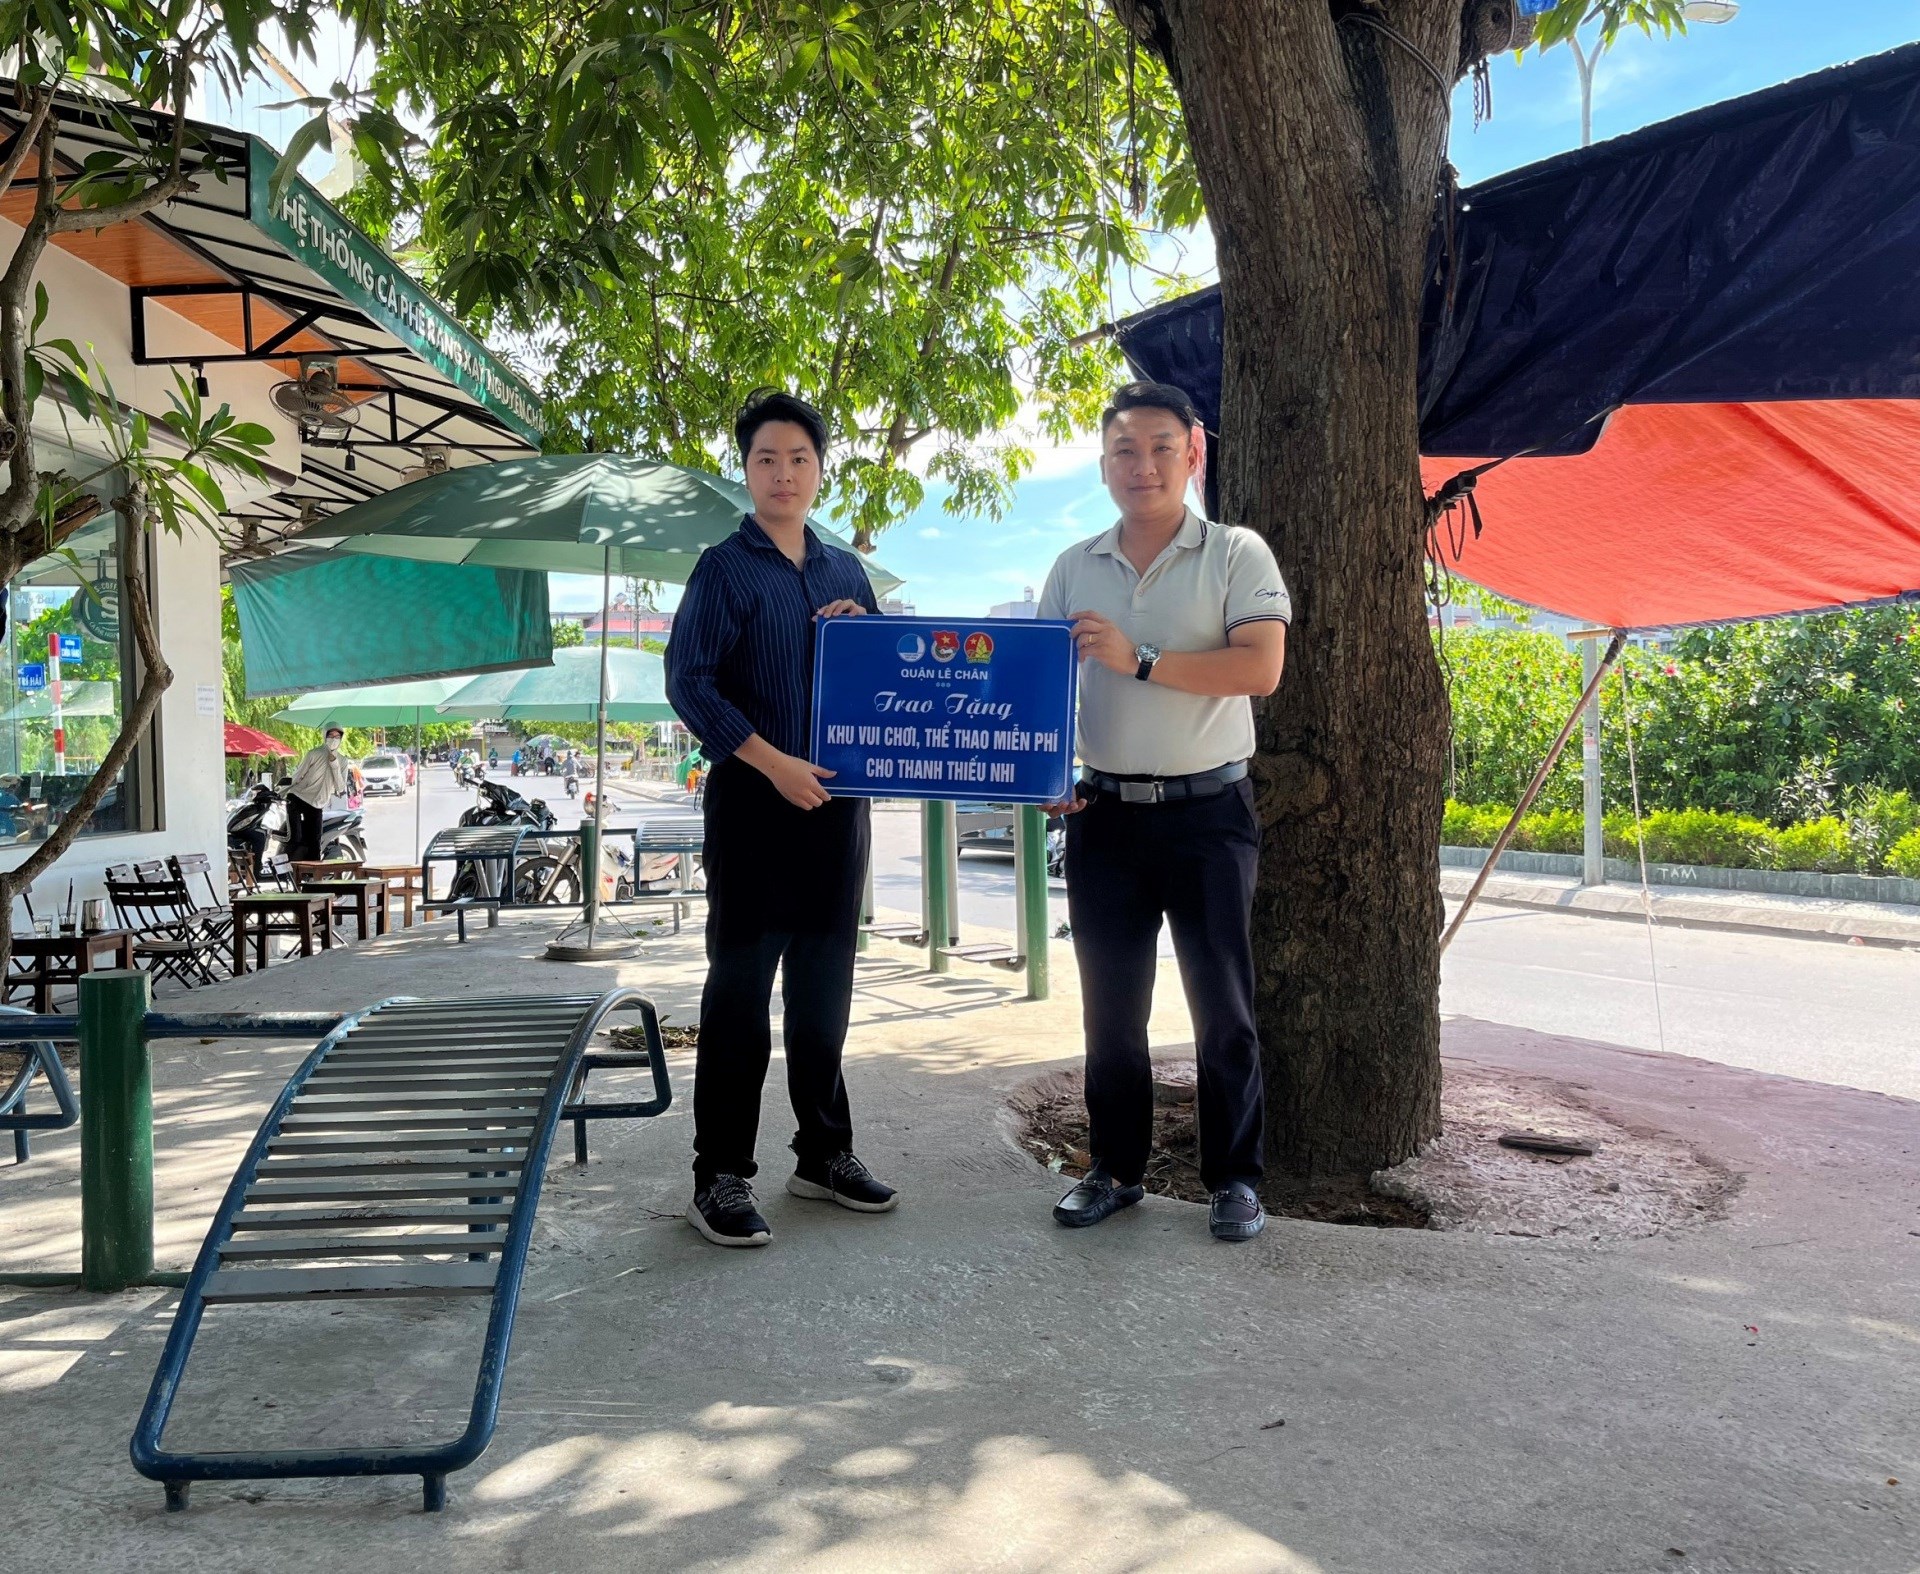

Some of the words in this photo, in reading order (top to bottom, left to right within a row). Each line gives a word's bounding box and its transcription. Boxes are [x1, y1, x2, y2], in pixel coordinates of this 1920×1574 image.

[280, 193, 308, 248] HỆ
[308, 214, 374, 291] THỐNG
[375, 273, 398, 318] CÀ
[398, 293, 427, 337] PHÊ
[427, 315, 462, 366] RANG
[901, 667, 935, 681] QUẬN
[938, 668, 952, 680] LÊ
[955, 669, 989, 681] CHÂN
[874, 691, 935, 713] Trao
[945, 693, 1014, 721] Tặng
[827, 725, 855, 745] KHU
[858, 726, 881, 746] VUI
[884, 726, 920, 750] CHƠI,
[924, 721, 951, 748] THỂ
[954, 728, 990, 750] THAO
[993, 724, 1031, 752] MIỄN
[1034, 728, 1059, 753] PHÍ
[866, 758, 894, 778] CHO
[897, 759, 943, 780] THANH
[947, 755, 986, 782] THIẾU
[990, 763, 1015, 783] NHI
